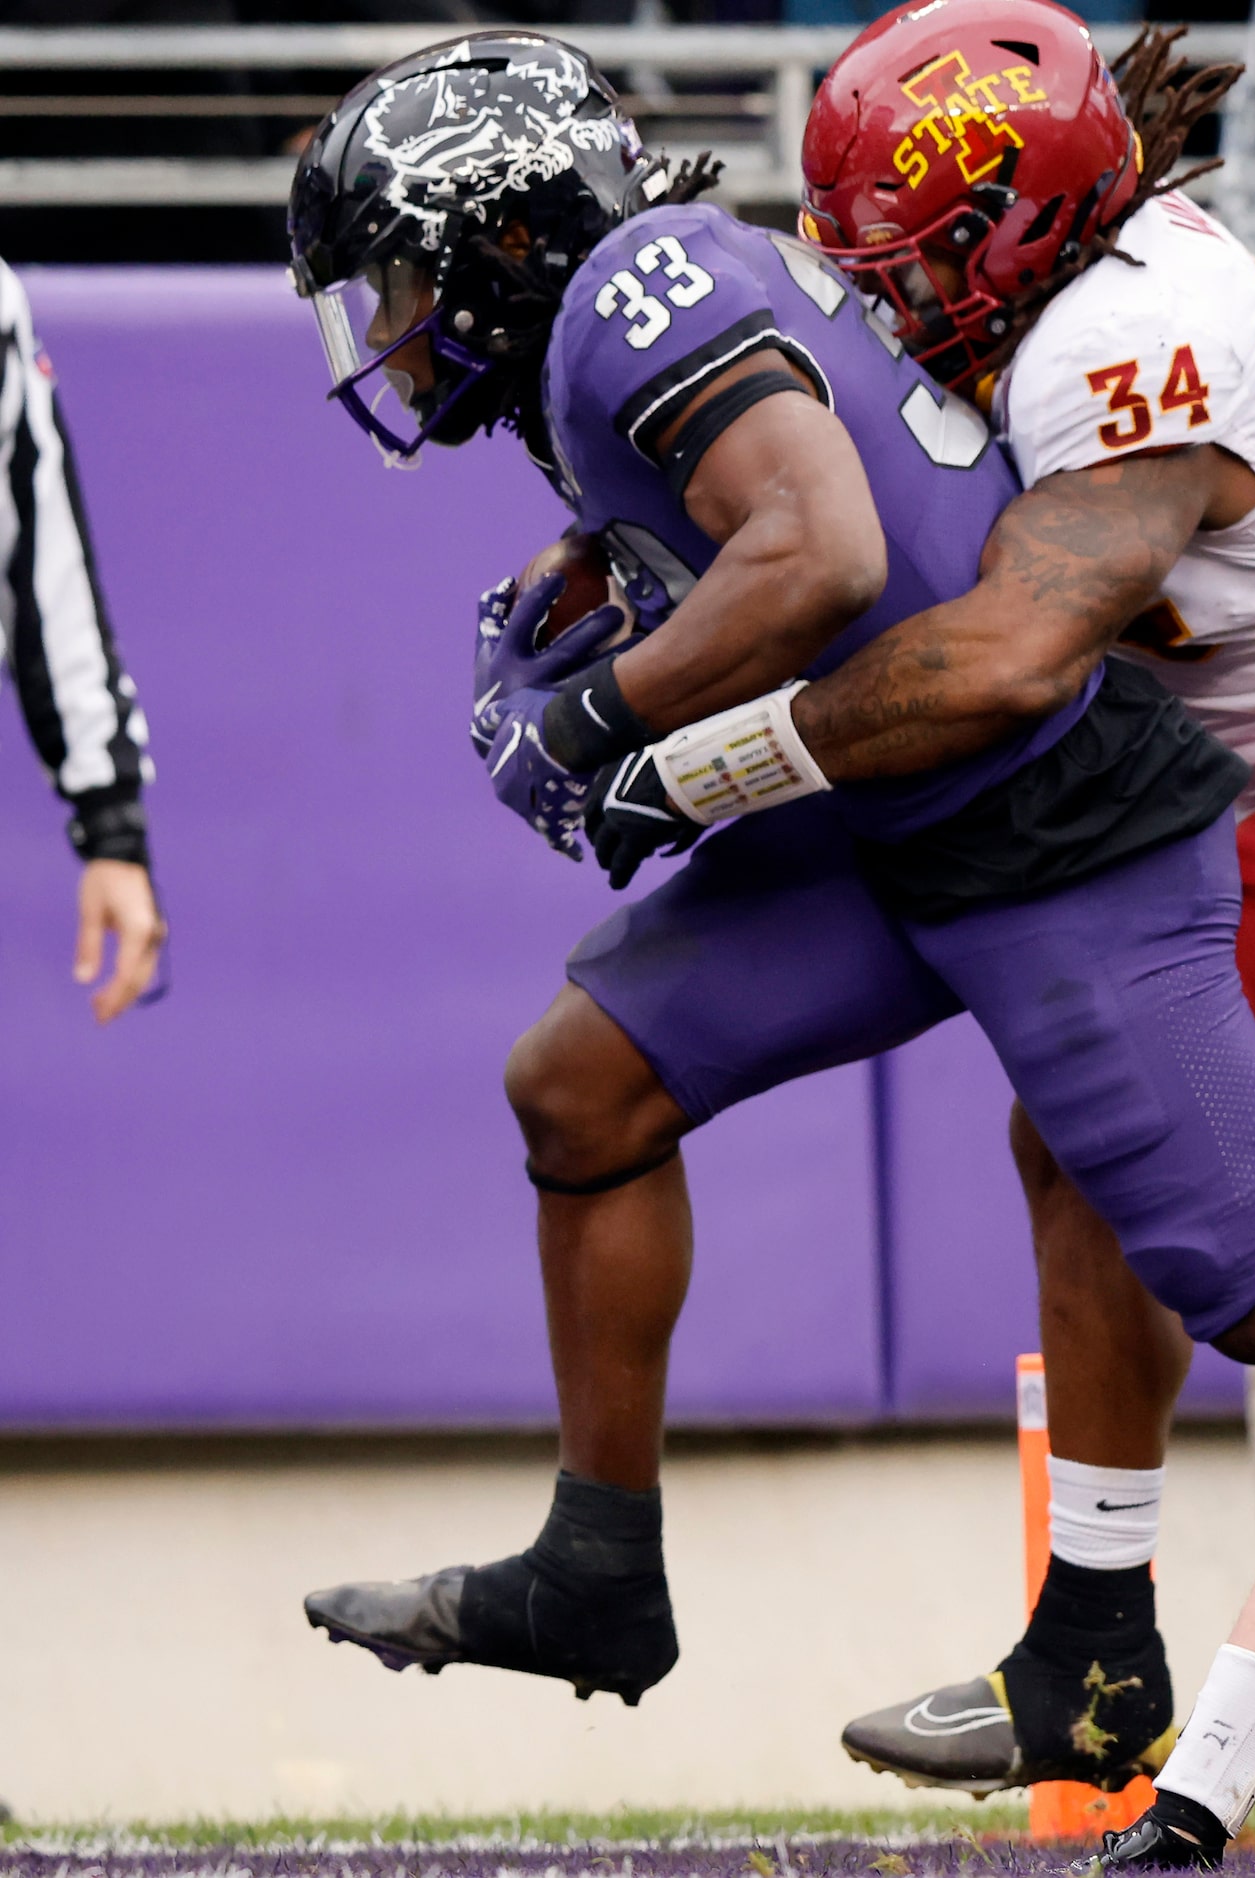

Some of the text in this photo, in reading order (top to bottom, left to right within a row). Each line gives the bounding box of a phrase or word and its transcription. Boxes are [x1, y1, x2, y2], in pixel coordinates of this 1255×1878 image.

[892, 65, 1048, 190] STATE
[594, 235, 716, 351] 33
[1084, 342, 1212, 450] 34
